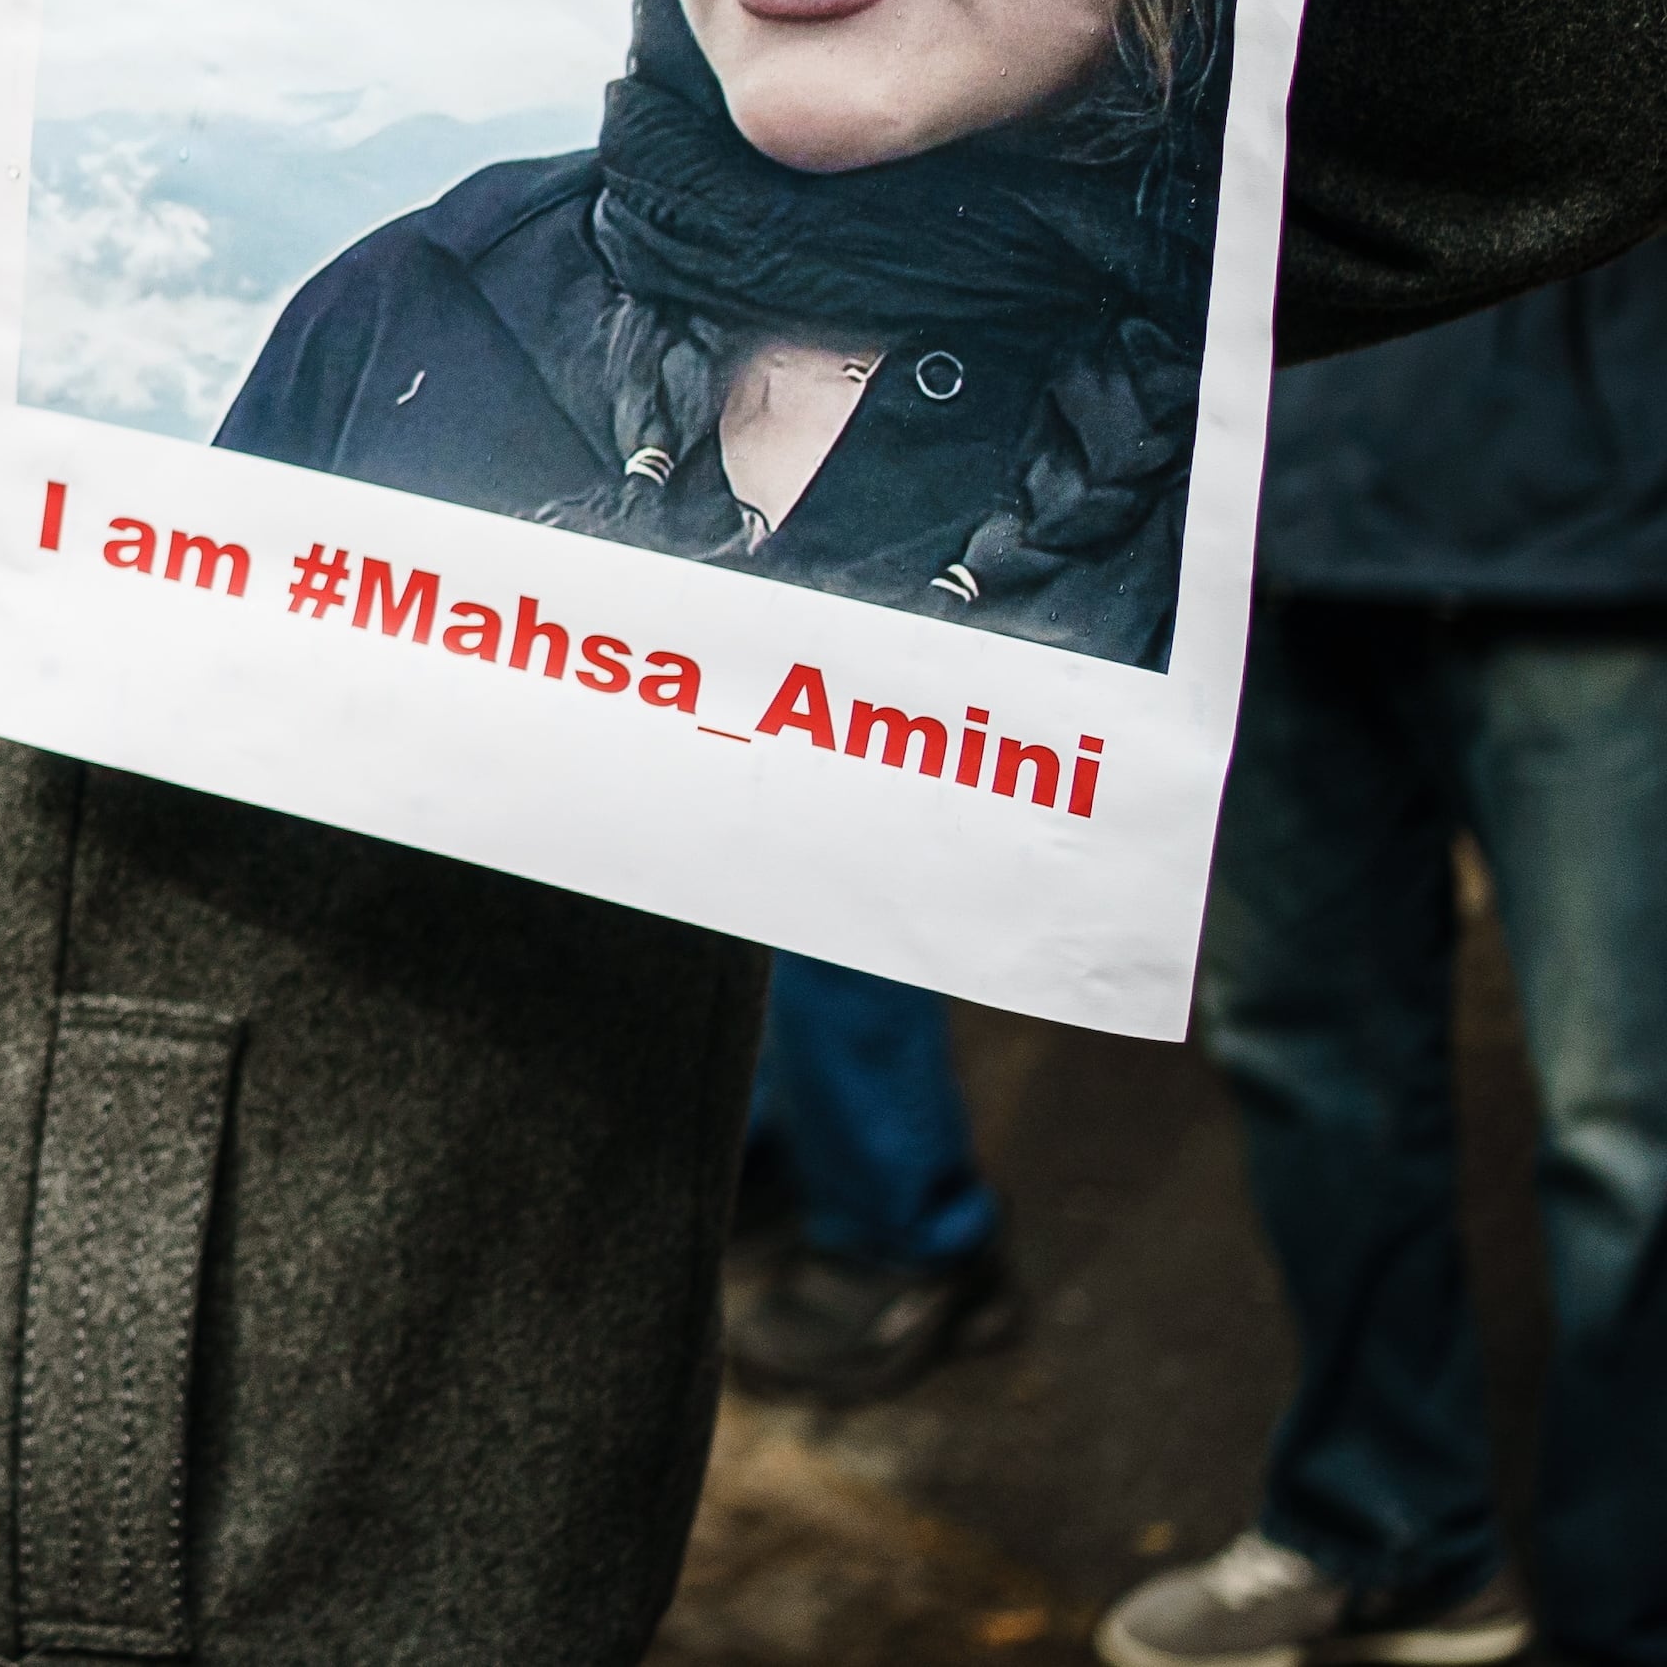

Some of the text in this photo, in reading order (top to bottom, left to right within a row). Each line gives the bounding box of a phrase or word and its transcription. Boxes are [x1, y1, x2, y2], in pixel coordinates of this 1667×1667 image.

[38, 480, 1105, 819] I am #Mahsa_Amini
